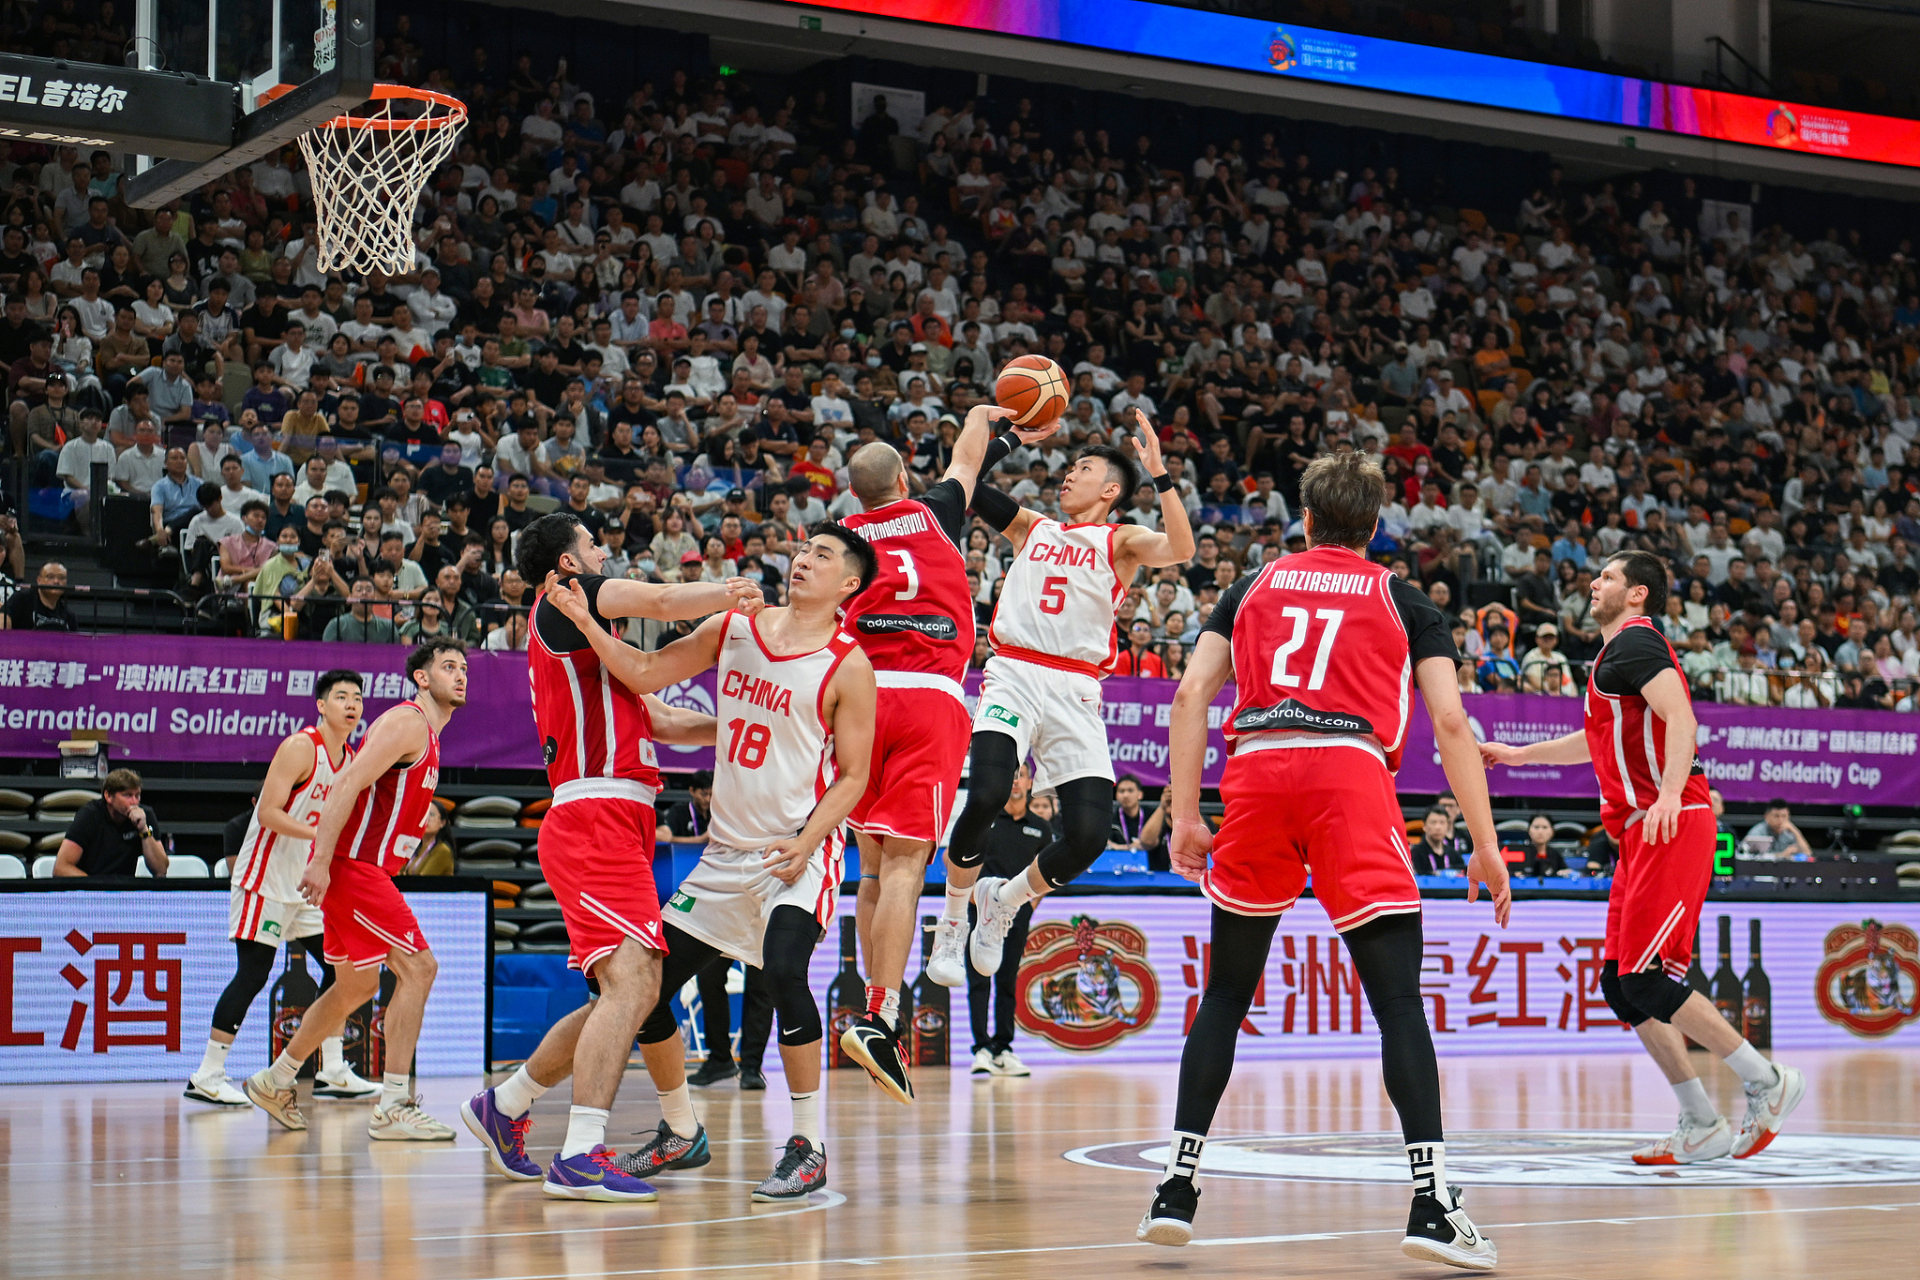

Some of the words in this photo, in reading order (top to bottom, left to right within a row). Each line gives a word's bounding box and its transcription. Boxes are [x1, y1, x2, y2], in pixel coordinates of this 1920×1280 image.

[41, 80, 128, 114] 吉诺尔
[1029, 542, 1097, 571] CHNA
[886, 549, 919, 601] 3
[1270, 570, 1373, 596] MAZIASHVILI
[1039, 576, 1068, 615] 5
[867, 618, 950, 633] adjarabet.com
[1271, 606, 1344, 691] 27
[722, 669, 793, 717] CHINA
[170, 707, 304, 736] Solidarity
[728, 717, 771, 770] 18
[1759, 759, 1843, 789] Solidarity
[1848, 762, 1881, 790] Cup
[1713, 833, 1735, 875] 2
